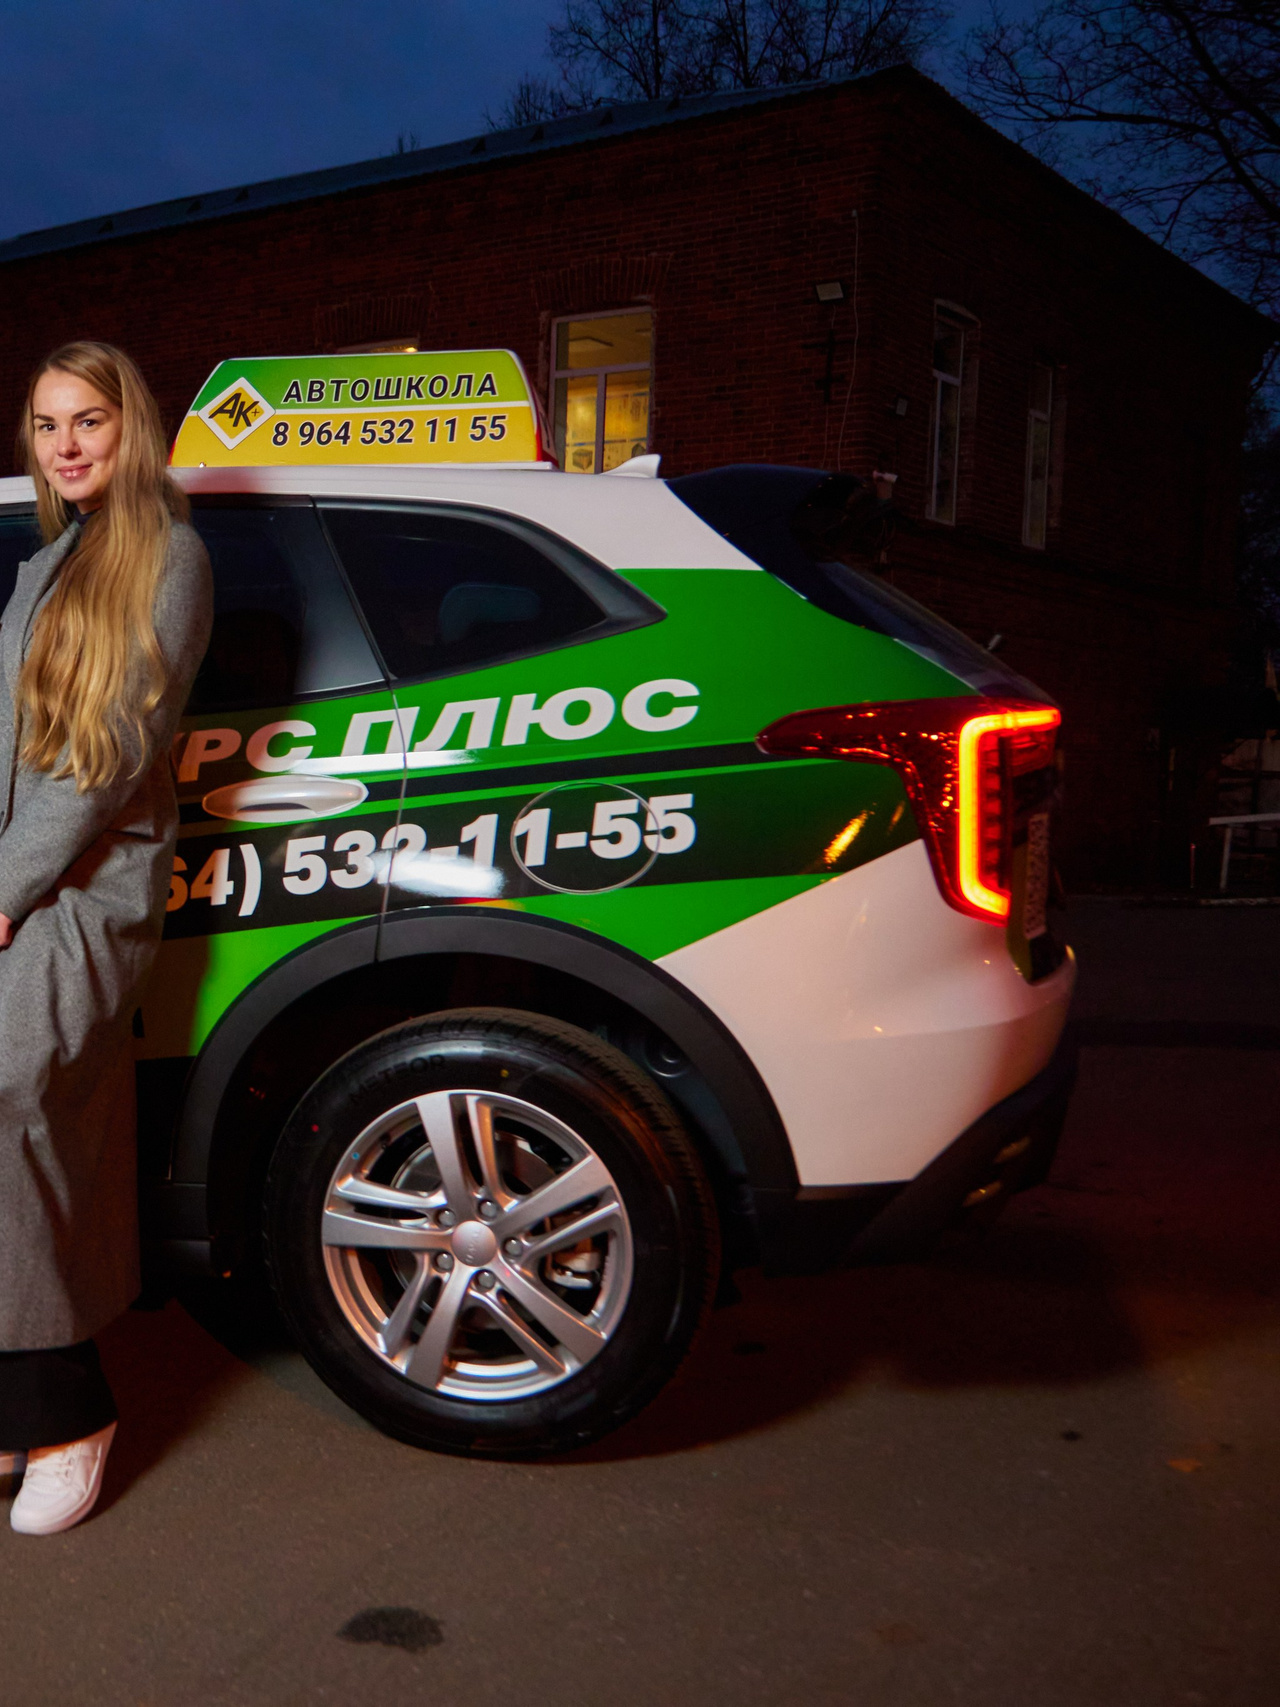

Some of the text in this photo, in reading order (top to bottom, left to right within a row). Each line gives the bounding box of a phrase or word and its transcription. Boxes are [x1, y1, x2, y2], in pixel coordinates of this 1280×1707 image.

[282, 373, 498, 404] АВТОШКОЛА
[271, 414, 508, 447] 8 964 532 11 55
[173, 678, 700, 783] РС ПЛЮС
[282, 793, 697, 895] 532-11-55
